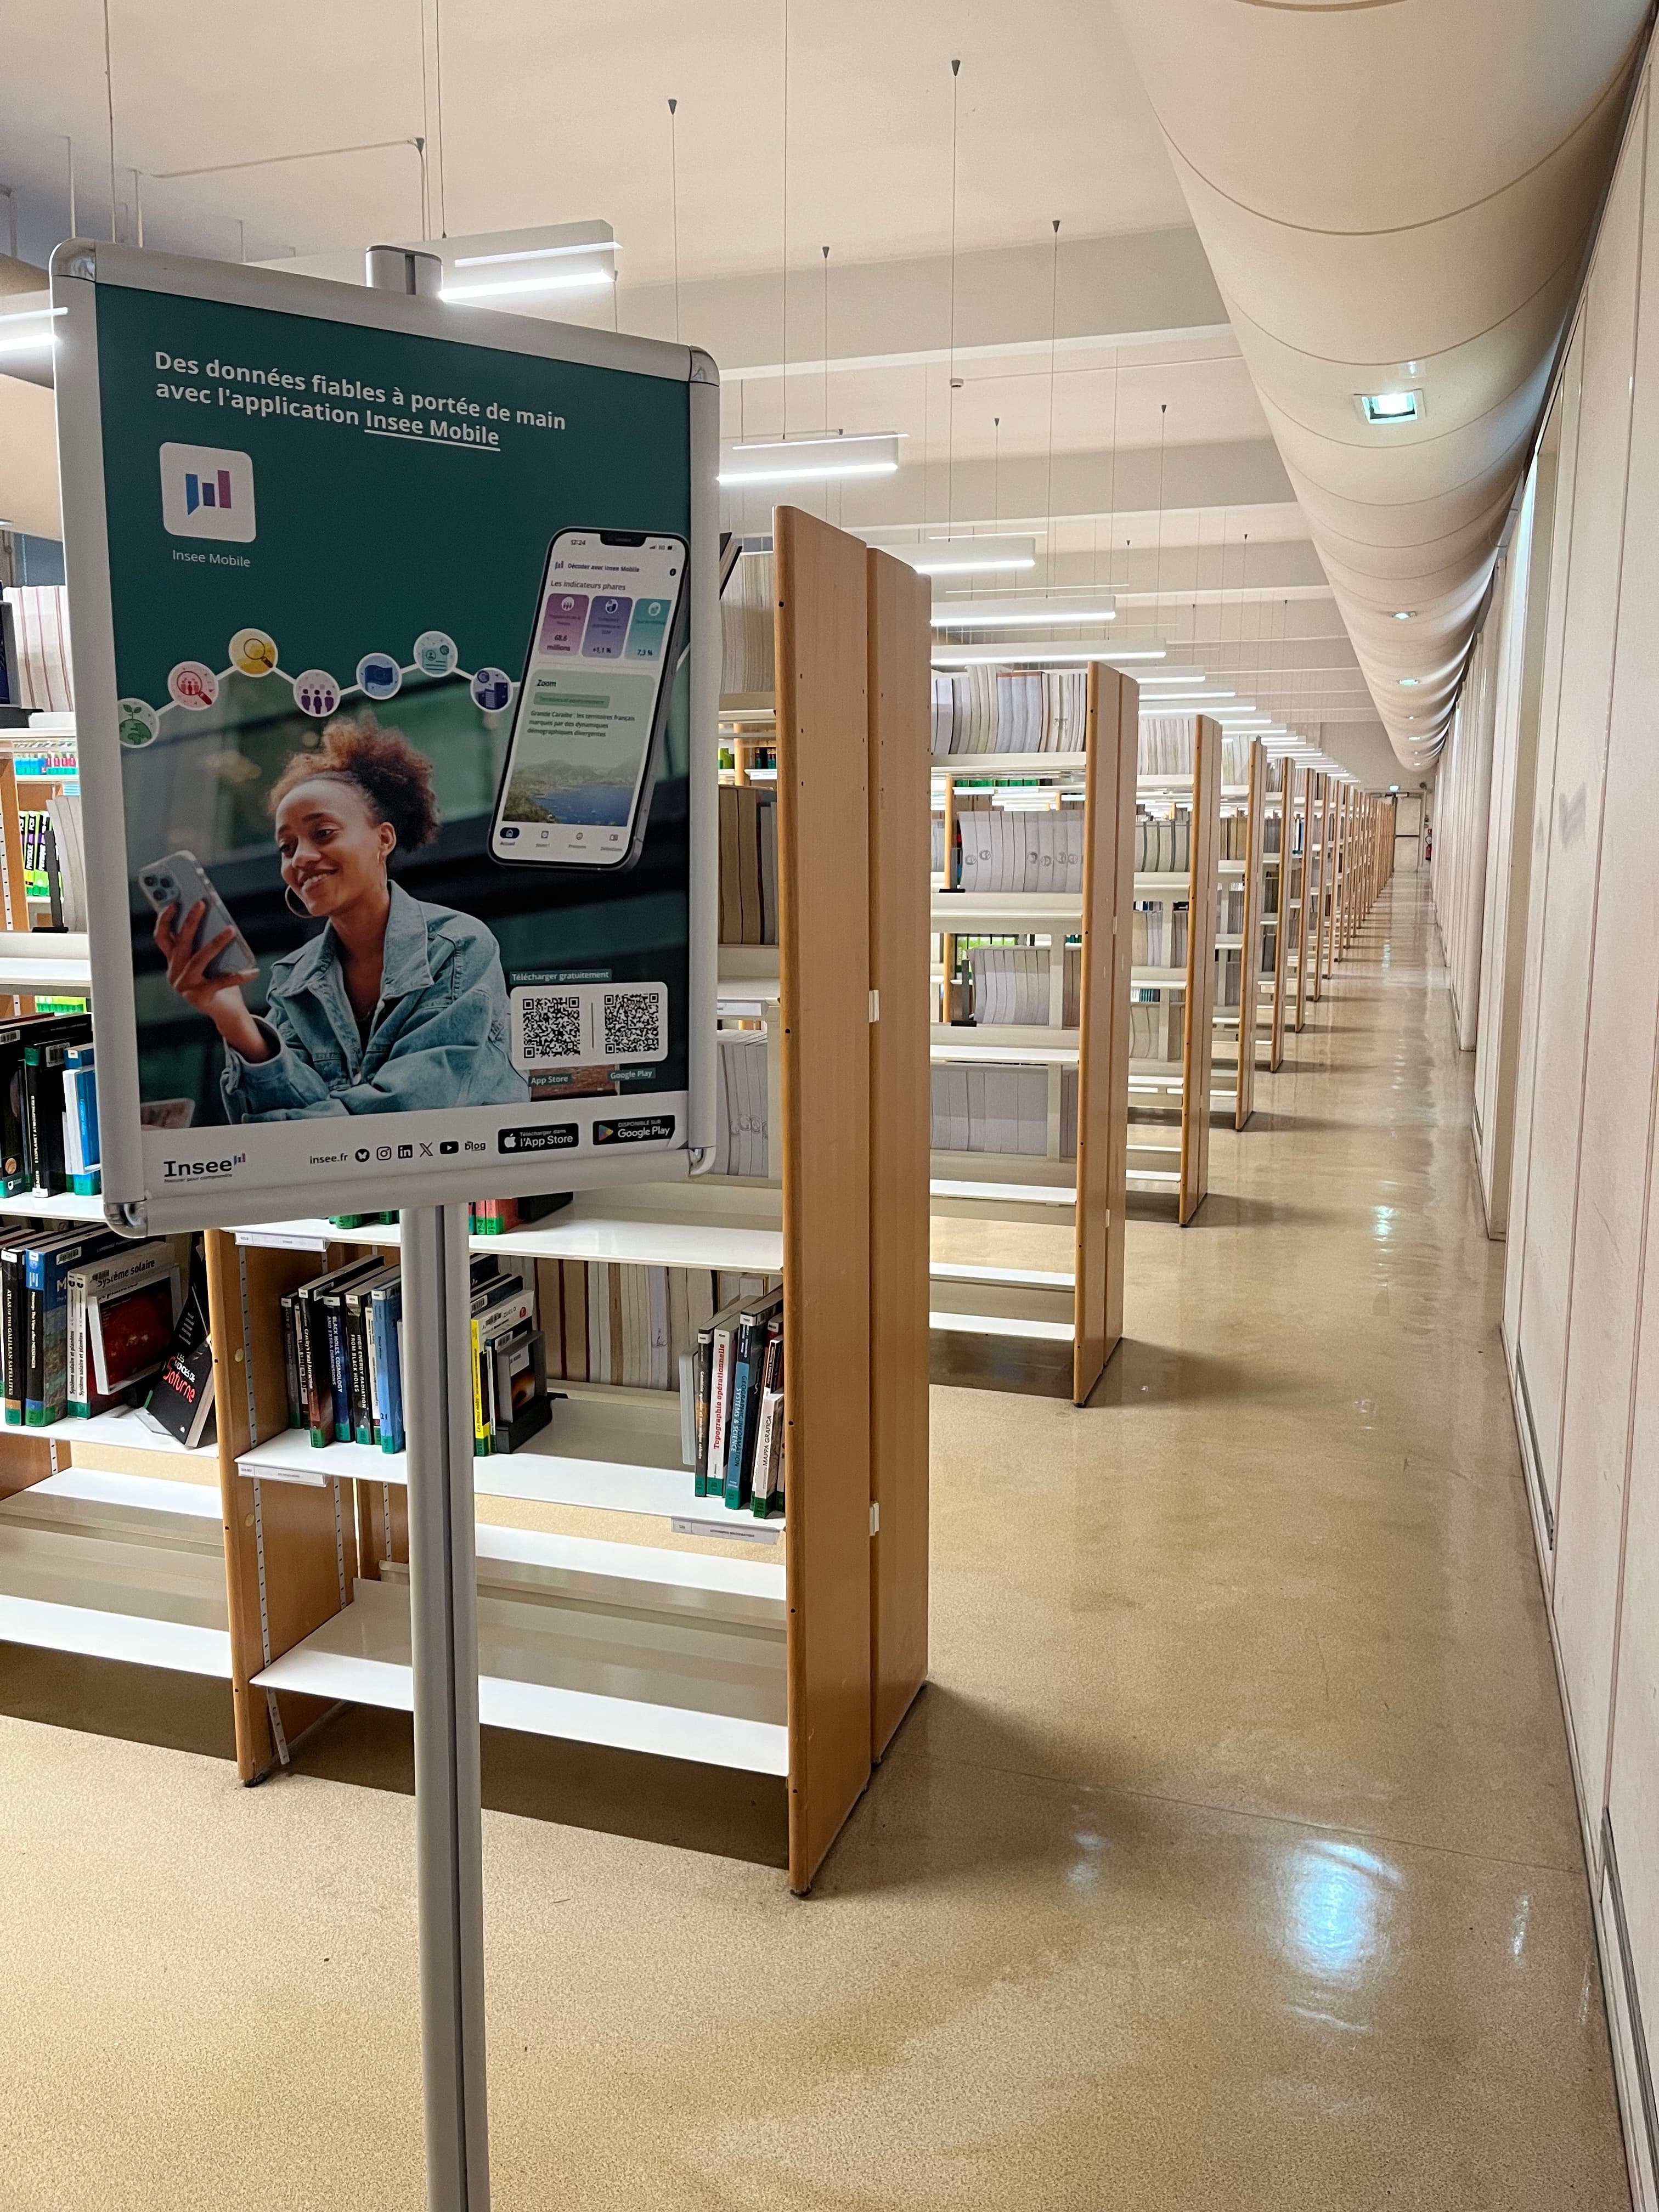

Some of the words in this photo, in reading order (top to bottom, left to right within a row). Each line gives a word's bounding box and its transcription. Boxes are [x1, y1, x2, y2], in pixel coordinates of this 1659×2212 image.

[155, 351, 200, 375] Des
[206, 359, 306, 391] données
[312, 374, 386, 403] fiables
[392, 387, 404, 406] à
[411, 393, 480, 417] portée
[486, 402, 510, 421] de
[516, 410, 566, 430] main
[156, 382, 212, 404] avec
[218, 387, 359, 425] l'application
[366, 410, 424, 435] Insee
[430, 419, 499, 445] Mobile
[172, 549, 206, 563] Insee
[209, 553, 251, 567] Mobile
[550, 579, 562, 588] Les
[563, 580, 601, 590] indicateurs
[537, 679, 556, 687] Zoom
[511, 973, 558, 983] Télécharger
[559, 970, 610, 981] gratuitement
[531, 1076, 547, 1085] App
[548, 1075, 569, 1084] Store
[610, 1070, 636, 1081] Google
[637, 1069, 653, 1079] Play
[519, 1130, 552, 1138] Télécharger
[618, 1127, 650, 1139] Google
[651, 1126, 670, 1137] Play
[520, 1137, 545, 1148] l'App
[546, 1135, 573, 1145] Store
[309, 1153, 348, 1164] insee.fr
[465, 1141, 486, 1152] blog
[163, 1160, 232, 1177] Insee
[130, 1259, 155, 1276] solaire
[162, 1356, 196, 1404] Saturne
[188, 1372, 196, 1383] DE
[335, 1356, 343, 1393] COSMOLOGY
[716, 1343, 725, 1400] opérationnelle
[738, 1375, 748, 1419] GEOGRAPHIC
[713, 1401, 721, 1449] Topographie
[730, 1424, 738, 1453] SCIENCE
[734, 1420, 744, 1467] INFORMATION
